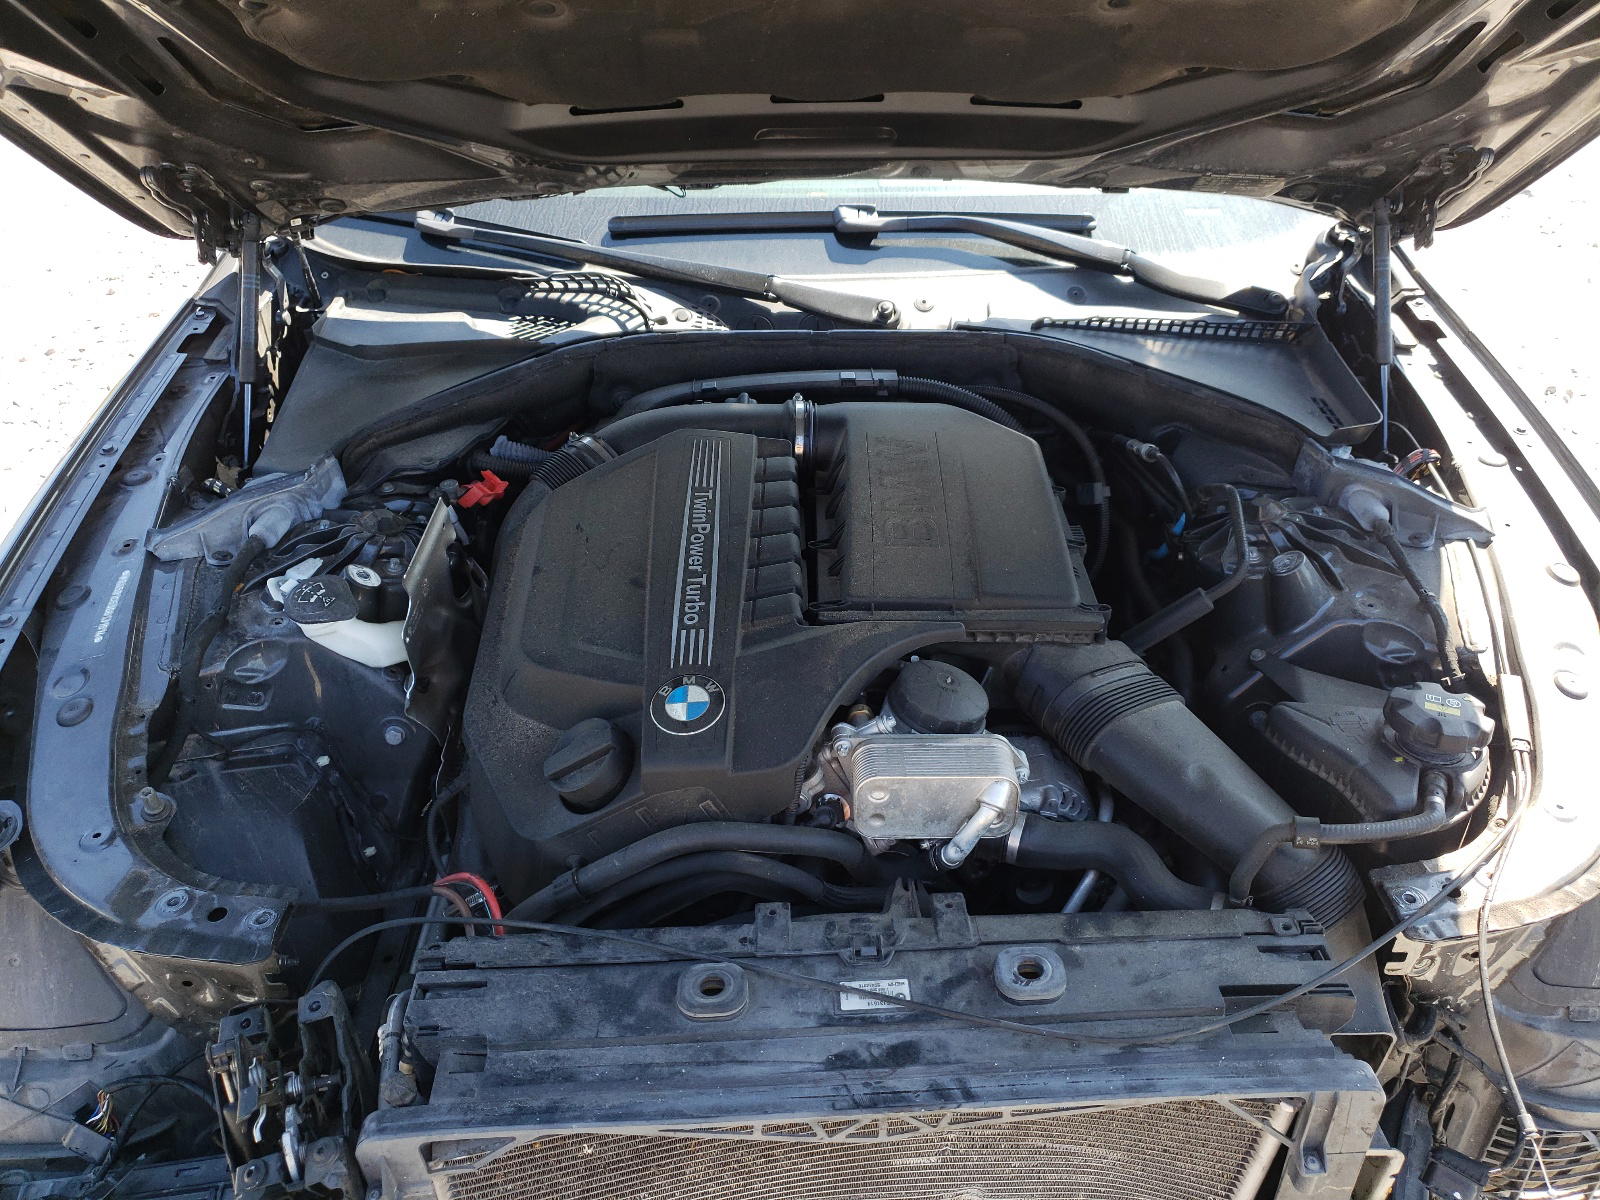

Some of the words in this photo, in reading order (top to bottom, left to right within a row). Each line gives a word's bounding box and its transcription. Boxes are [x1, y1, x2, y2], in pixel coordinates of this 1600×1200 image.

[688, 490, 713, 571] TwinPower
[683, 573, 707, 625] Turbo
[658, 675, 720, 697] BMW
